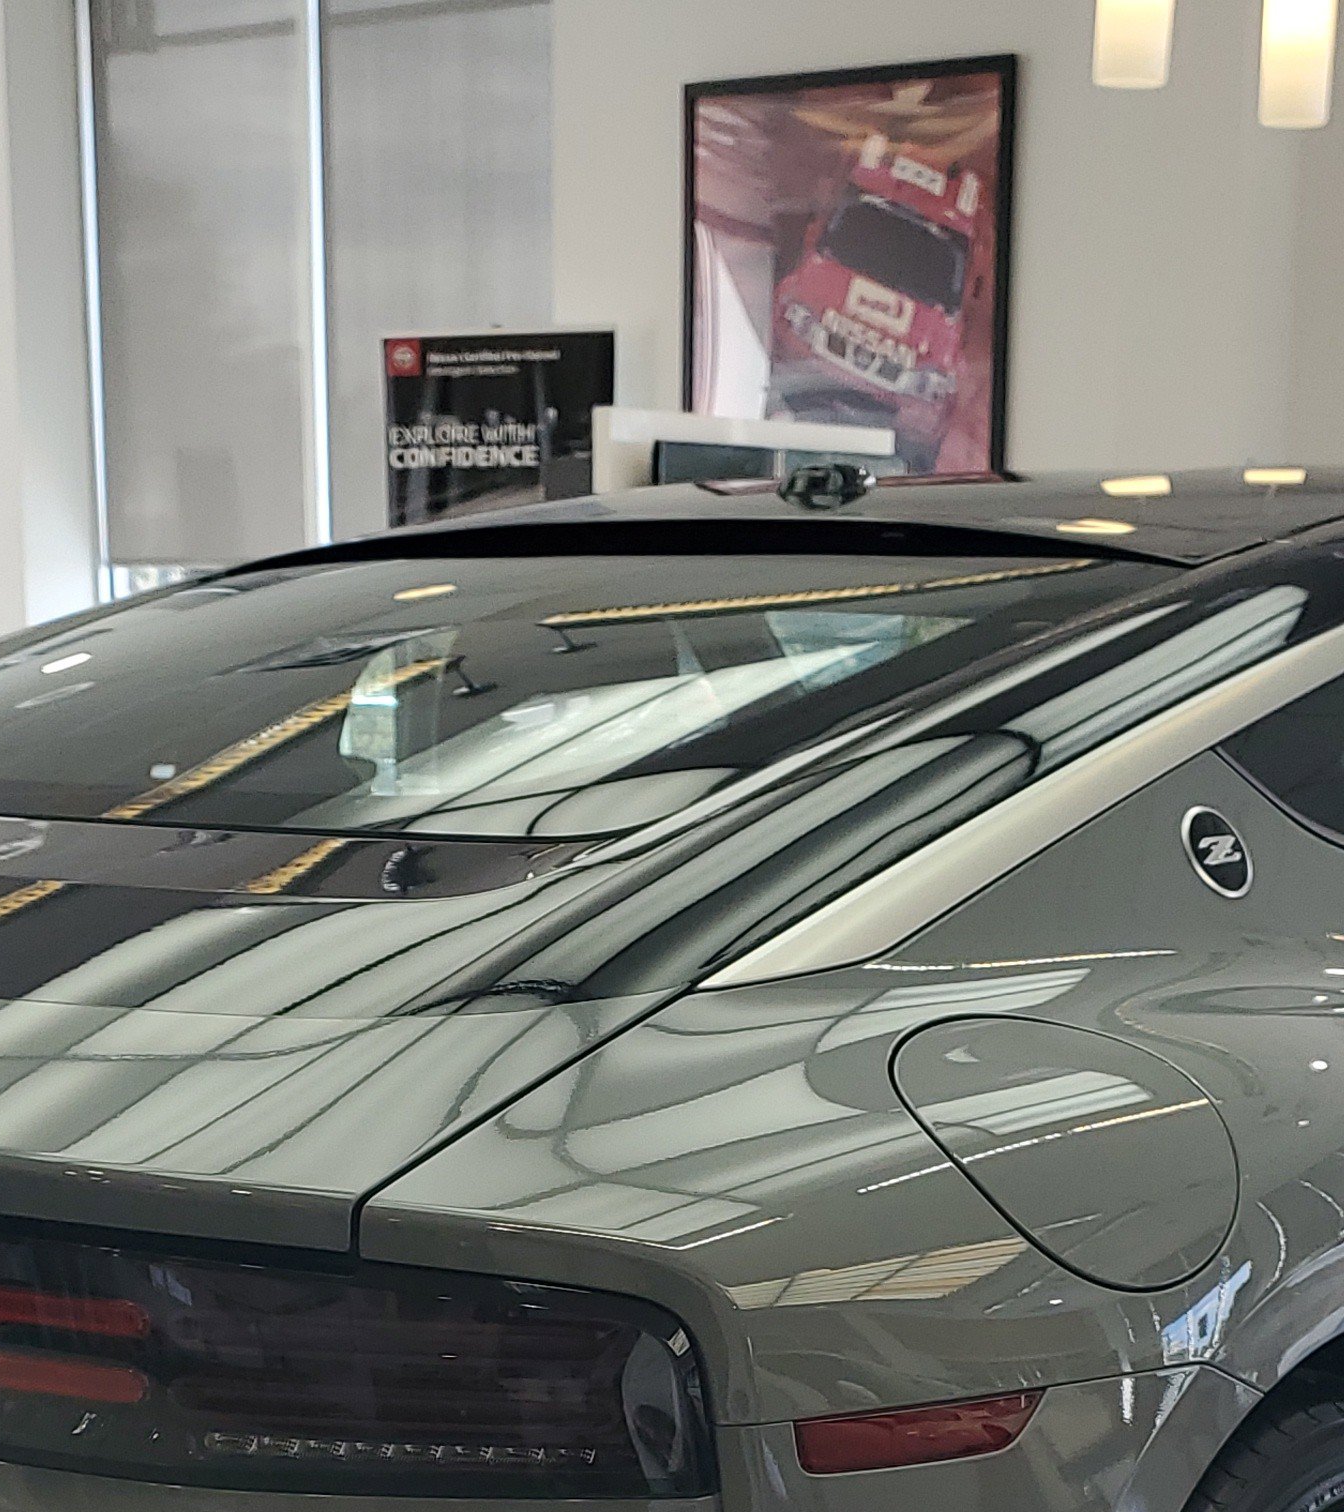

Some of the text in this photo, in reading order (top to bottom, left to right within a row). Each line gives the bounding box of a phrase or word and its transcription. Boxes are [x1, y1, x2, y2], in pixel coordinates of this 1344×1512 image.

[388, 423, 536, 445] EXPLORE WITH
[388, 445, 540, 468] CONFIDENCE
[1197, 834, 1243, 866] Z
